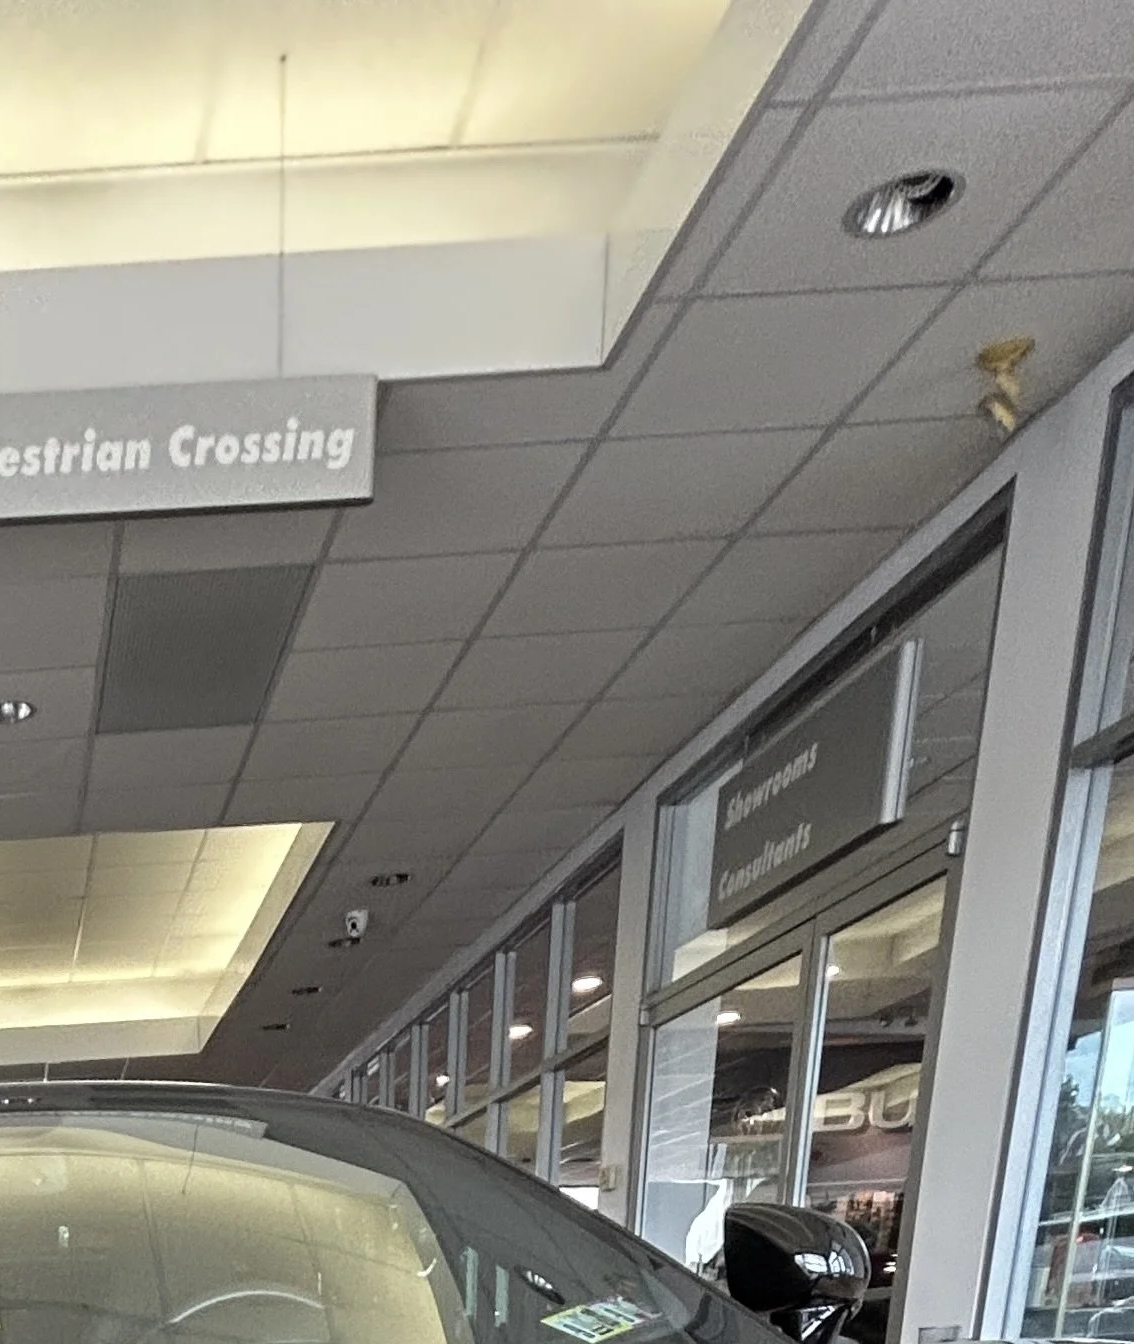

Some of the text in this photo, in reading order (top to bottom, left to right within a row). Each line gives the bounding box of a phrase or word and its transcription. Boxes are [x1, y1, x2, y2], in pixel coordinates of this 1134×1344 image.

[168, 415, 356, 471] Crossing
[724, 742, 818, 831] Showrooms
[718, 822, 812, 900] Consultants
